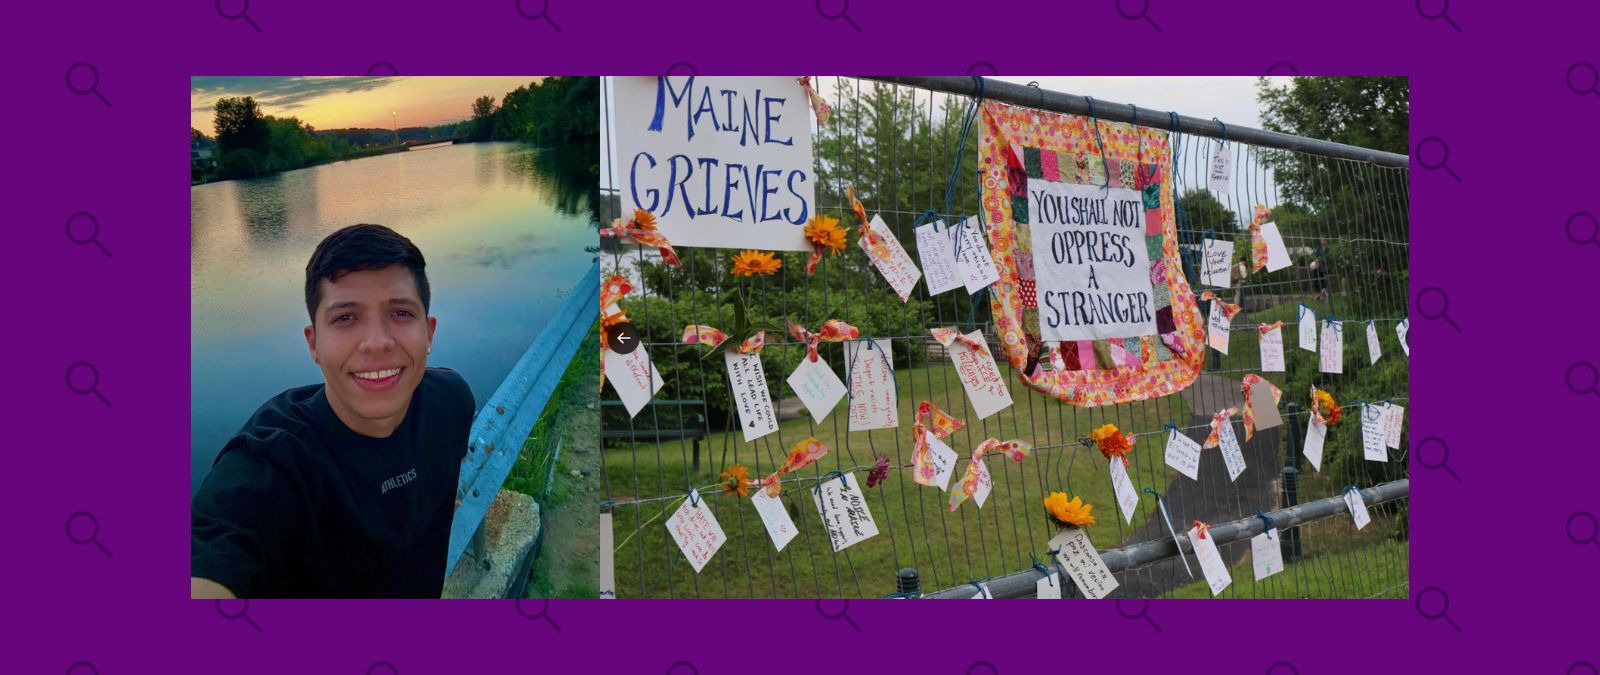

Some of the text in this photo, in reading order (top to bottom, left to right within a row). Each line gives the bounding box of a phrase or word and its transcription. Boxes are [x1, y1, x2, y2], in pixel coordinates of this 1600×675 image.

[648, 76, 794, 146] MAINE
[630, 152, 808, 225] GRIEVES
[1032, 190, 1140, 228] YOU SHALL NOT
[970, 230, 980, 243] You
[976, 244, 984, 252] do
[1051, 230, 1135, 268] OPPRESS
[1088, 264, 1100, 290] A
[1044, 290, 1152, 328] STRANGER
[733, 362, 751, 414] WITH LOVE
[742, 358, 763, 422] ALL LEAD LIFE
[978, 364, 992, 382] ICE
[985, 361, 1004, 397] need to
[753, 363, 764, 386] WISH
[760, 390, 768, 402] WE
[764, 405, 774, 430] COULD
[382, 468, 417, 494] ATHLETICS
[846, 506, 864, 536] MAINE
[1066, 542, 1080, 556] paz
[1088, 570, 1104, 590] vecino
[1100, 570, 1108, 580] en
